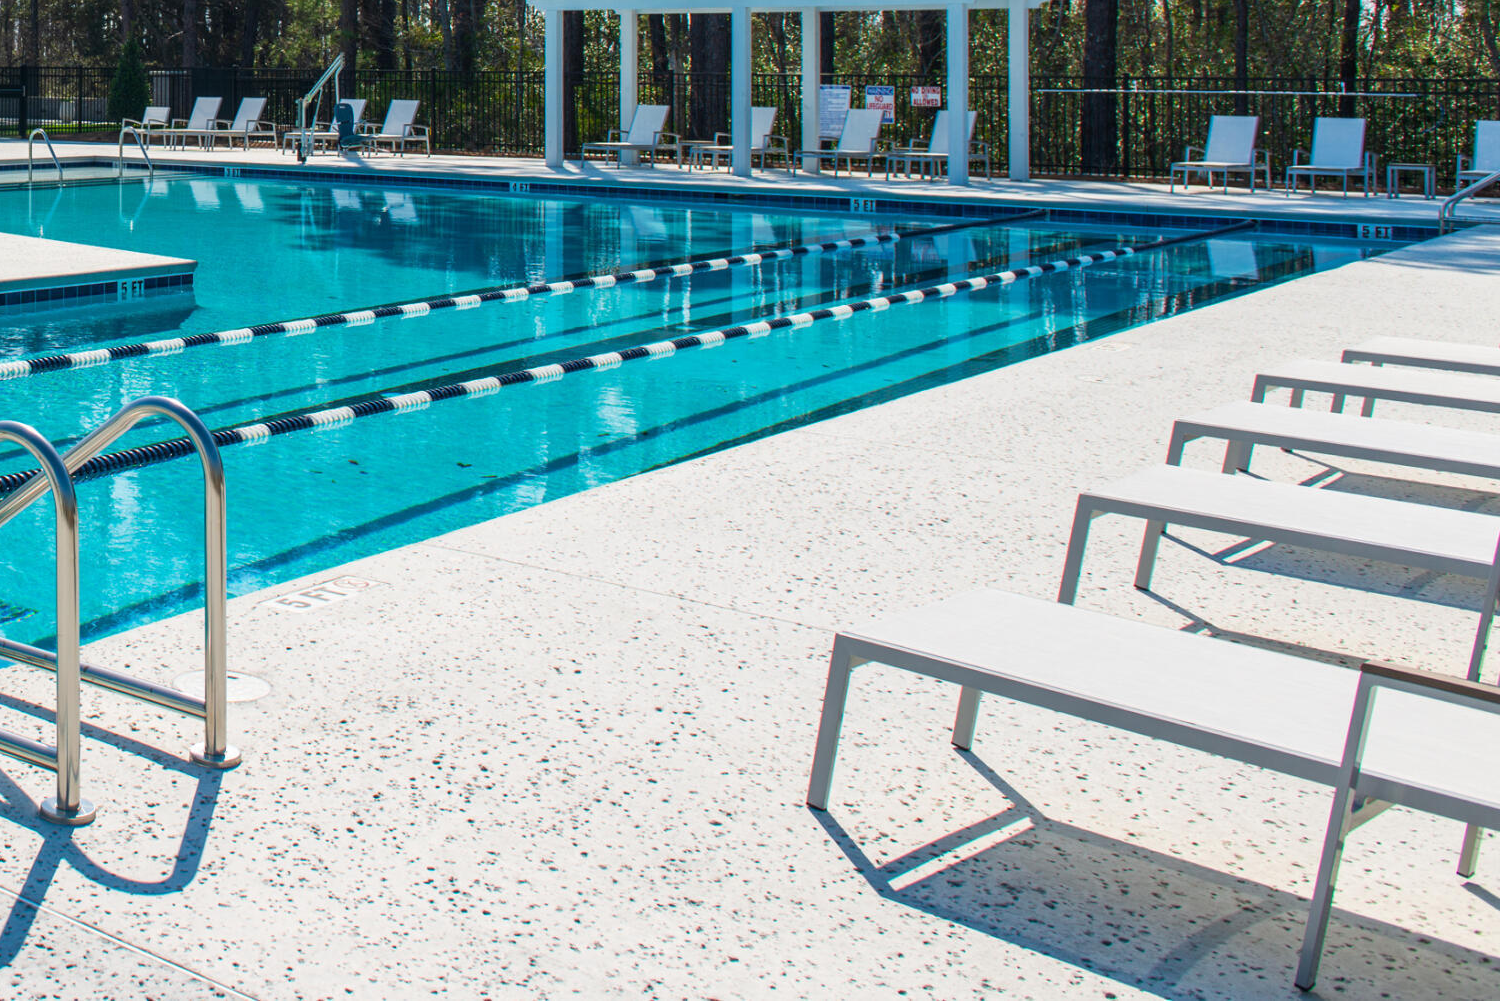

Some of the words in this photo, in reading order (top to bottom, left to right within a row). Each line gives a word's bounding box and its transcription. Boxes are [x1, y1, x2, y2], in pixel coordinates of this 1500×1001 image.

[911, 86, 918, 94] NO
[921, 86, 940, 94] DIVING
[276, 597, 312, 608] 5
[298, 586, 349, 602] FT
